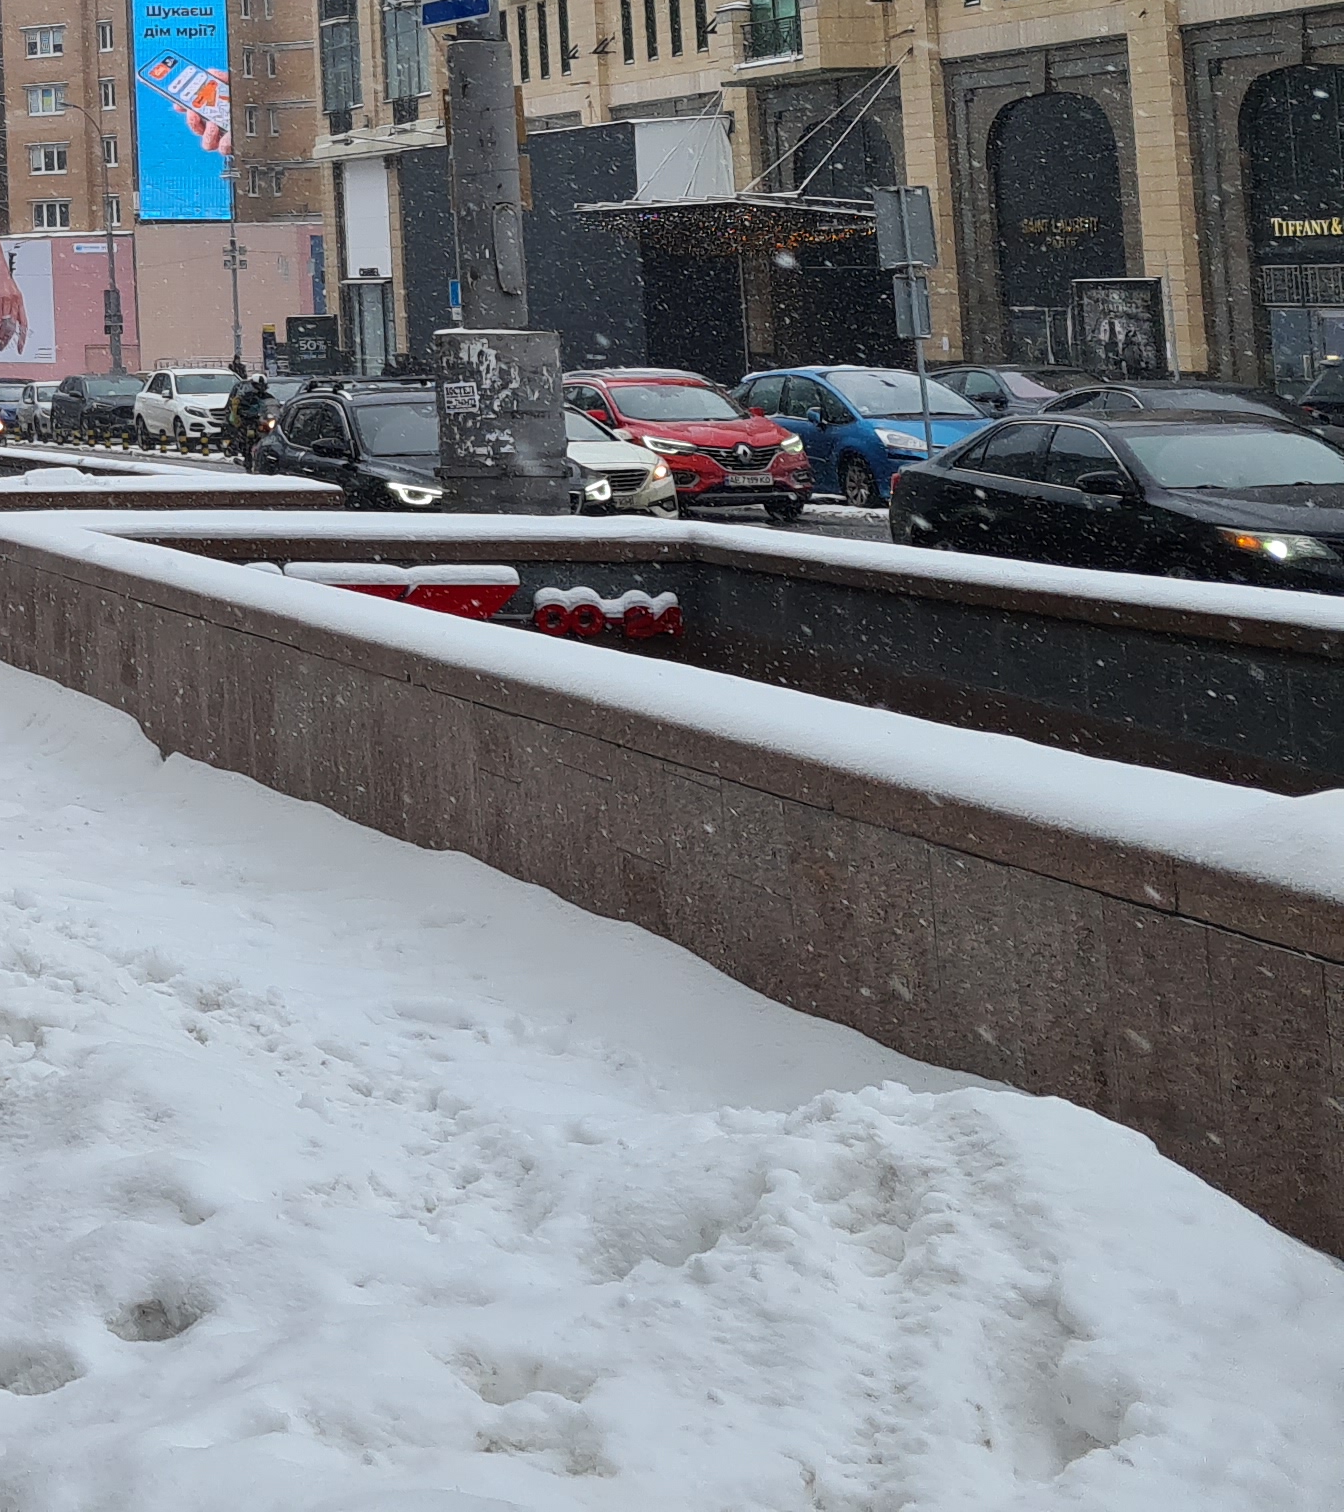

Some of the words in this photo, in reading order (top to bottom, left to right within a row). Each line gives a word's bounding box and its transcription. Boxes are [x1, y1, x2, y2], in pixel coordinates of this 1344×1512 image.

[146, 5, 213, 19] Шукаєш
[144, 25, 171, 38] дім
[176, 23, 216, 39] мрії?
[1270, 218, 1330, 236] TIFFANY
